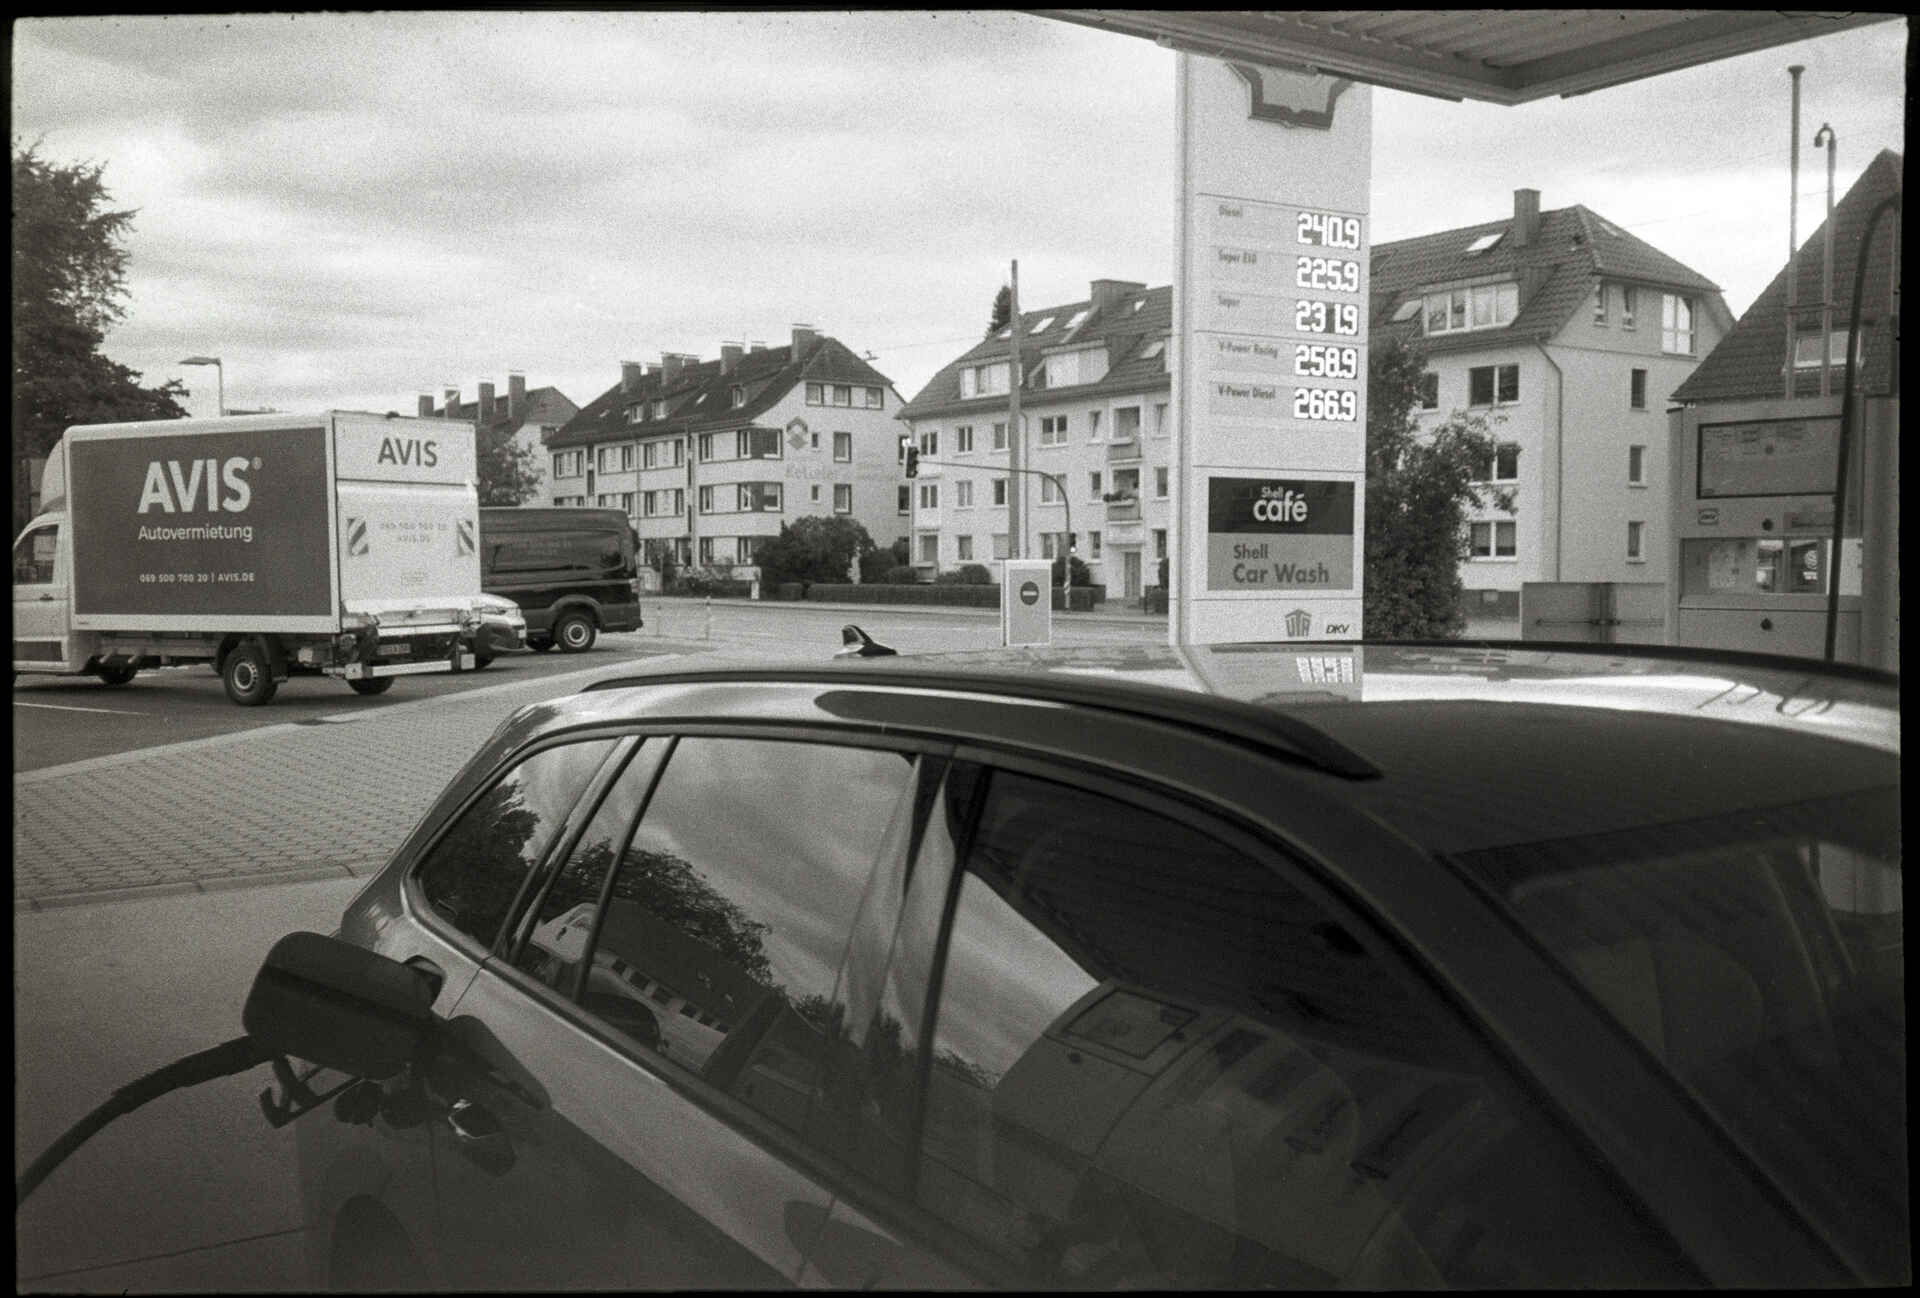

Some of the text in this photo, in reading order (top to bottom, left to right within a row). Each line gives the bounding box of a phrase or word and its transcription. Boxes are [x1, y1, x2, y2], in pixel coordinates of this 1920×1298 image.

[1297, 212, 1361, 250] 240.9
[1296, 257, 1360, 292] 225.9
[1294, 344, 1358, 379] 258.9
[1293, 387, 1357, 422] 266.9
[377, 437, 438, 468] AVIS
[1261, 486, 1283, 499] Shell
[1253, 490, 1308, 522] café
[138, 522, 253, 543] Autovermietung
[1232, 543, 1269, 560] Shell
[158, 573, 175, 583] 500
[177, 573, 194, 583] 700
[197, 573, 208, 583] 20
[217, 571, 255, 582] AVIS.DE
[1232, 562, 1330, 584] Car Wash
[1325, 623, 1350, 635] DKV
